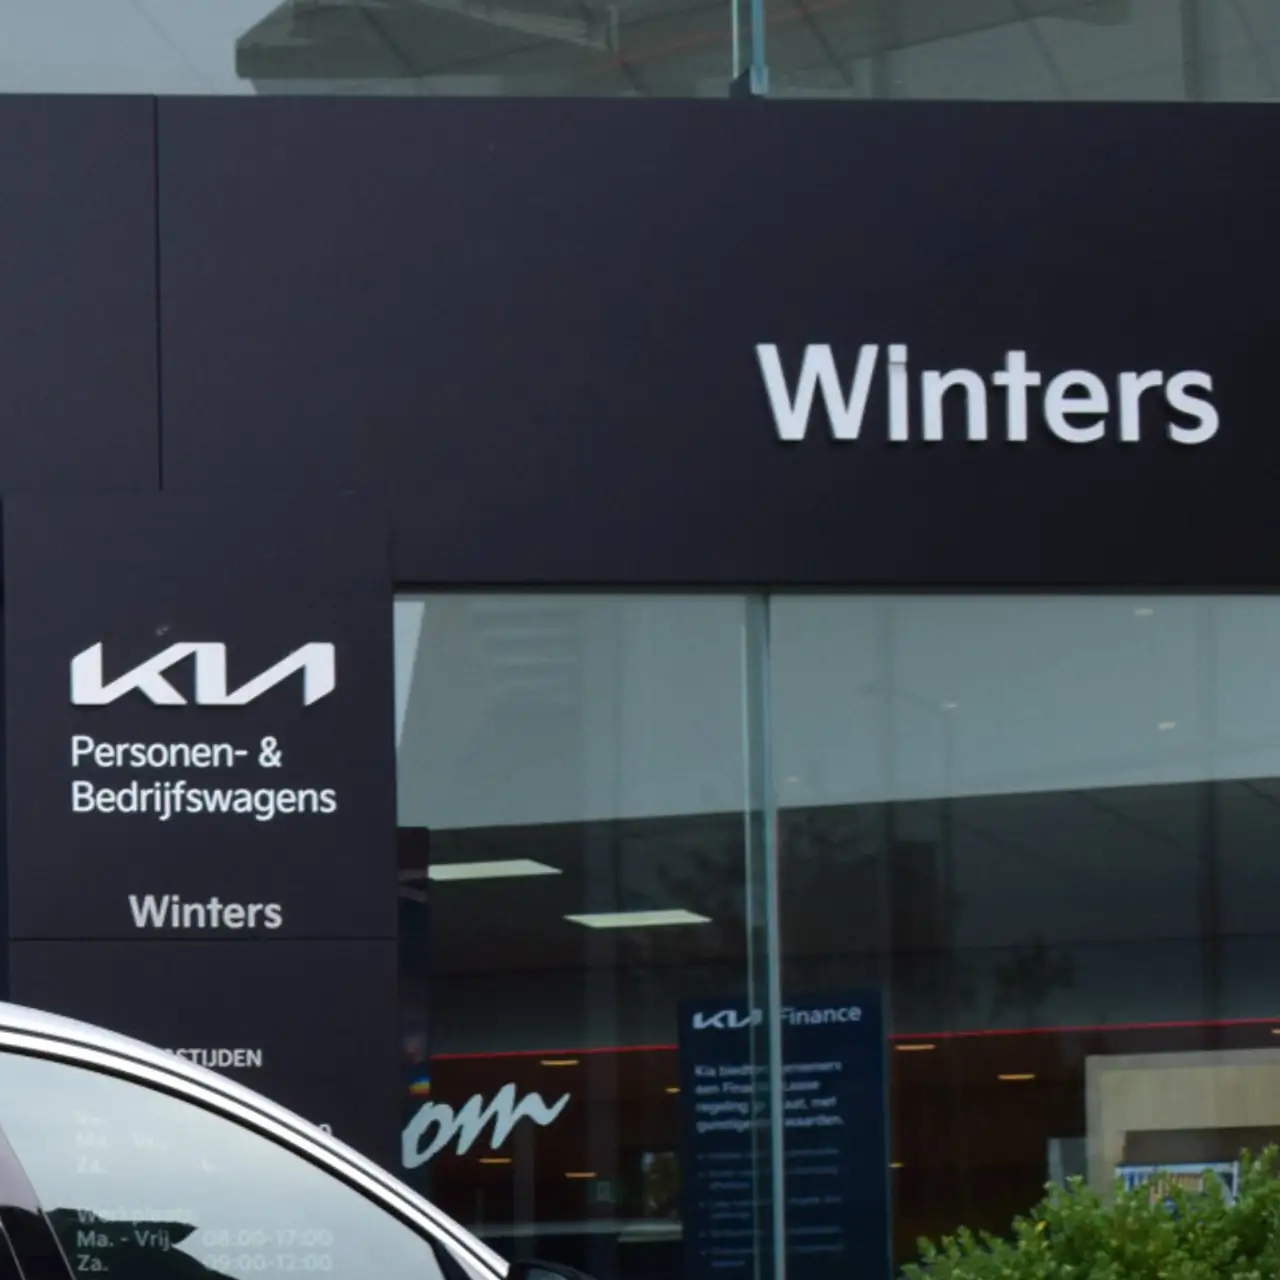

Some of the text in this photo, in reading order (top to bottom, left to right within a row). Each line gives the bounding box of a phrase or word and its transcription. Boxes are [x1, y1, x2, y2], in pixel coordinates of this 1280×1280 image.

[755, 342, 1220, 445] Winters
[70, 641, 336, 706] KIA
[71, 735, 283, 768] Personen- &
[71, 780, 338, 821] Bedrijfswagens
[128, 894, 283, 929] Winters
[76, 1231, 114, 1248] Ma.
[76, 1254, 109, 1272] Za.
